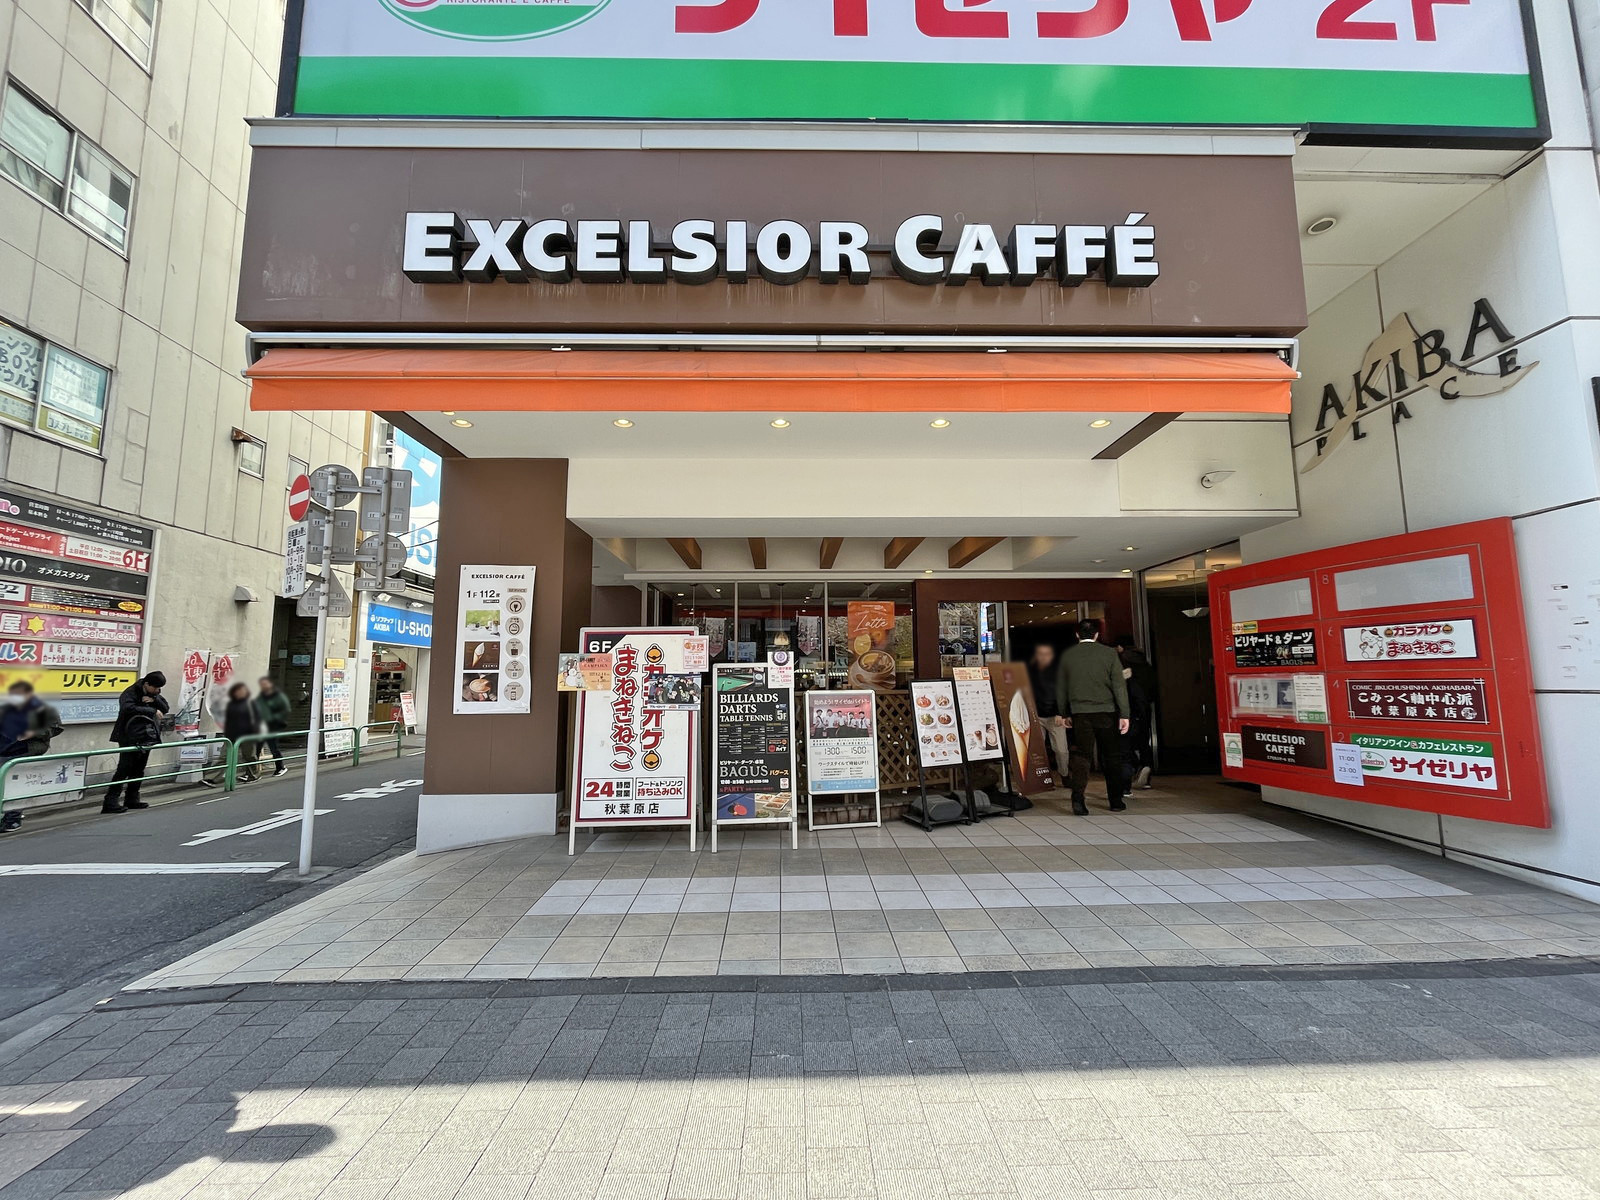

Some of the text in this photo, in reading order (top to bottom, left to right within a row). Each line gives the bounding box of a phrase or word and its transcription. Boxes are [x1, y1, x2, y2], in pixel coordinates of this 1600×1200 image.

[402, 211, 1160, 282] EXCELSIOR CAFFÉ
[1315, 297, 1516, 432] AKIBA
[37, 566, 92, 582] オメガスタジオ
[373, 621, 390, 632] AKIBA
[397, 618, 432, 638] U-SHO
[853, 614, 888, 633] Latte
[51, 626, 137, 642] www.Getchu.com
[1393, 624, 1443, 638] カラオケ
[588, 640, 612, 653] 6F
[1234, 631, 1313, 648] ビリヤード & ダーツ
[1386, 639, 1456, 658] まねきねこ
[62, 673, 130, 688] リバティー
[719, 693, 779, 704] BILLIARDS
[1357, 692, 1474, 707] こみっく軸中心派
[610, 643, 640, 771] まねきねこ
[719, 703, 758, 714] DARTS
[1371, 705, 1458, 719] 秋葉原本店
[719, 714, 774, 723] TABLE TENNIS
[1255, 732, 1307, 746] EXCELSIOR
[824, 746, 840, 756] 1300
[1265, 743, 1297, 756] CAFFÉ
[1338, 755, 1356, 763] 11:00
[719, 765, 769, 778] BAGUS
[1338, 766, 1357, 774] 23:00
[1389, 756, 1493, 782] サイゼリヤ
[585, 781, 615, 798] 24
[616, 781, 631, 789] 時間
[637, 787, 683, 797] 持ち込みOK
[616, 789, 631, 798] 営業
[604, 802, 660, 815] 秋葉原店
